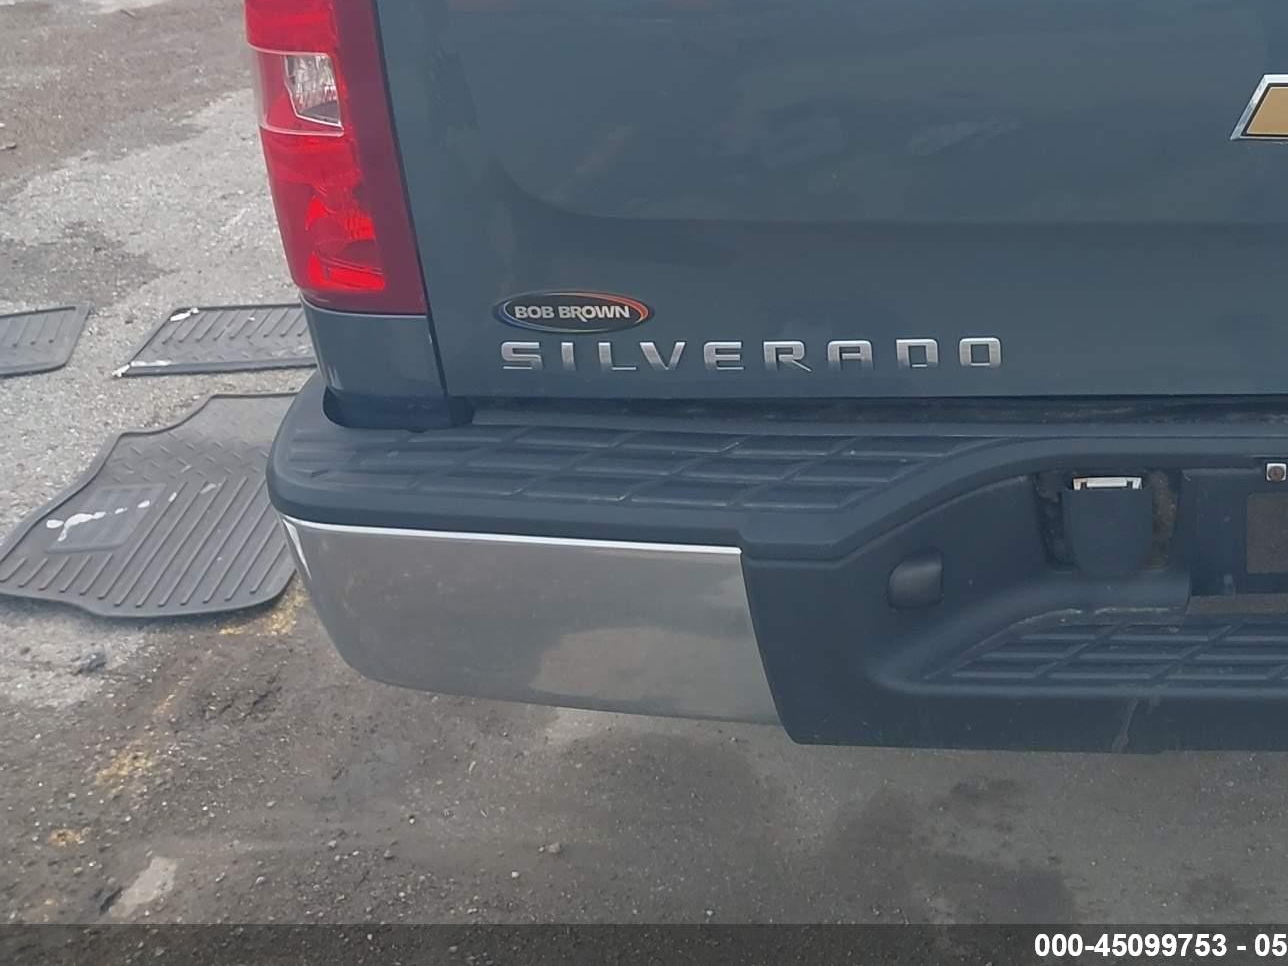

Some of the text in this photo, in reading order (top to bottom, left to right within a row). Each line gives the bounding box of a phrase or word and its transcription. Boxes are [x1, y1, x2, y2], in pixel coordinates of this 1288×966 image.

[514, 305, 631, 323] BOB BROWN
[500, 336, 1001, 373] SILVERADO
